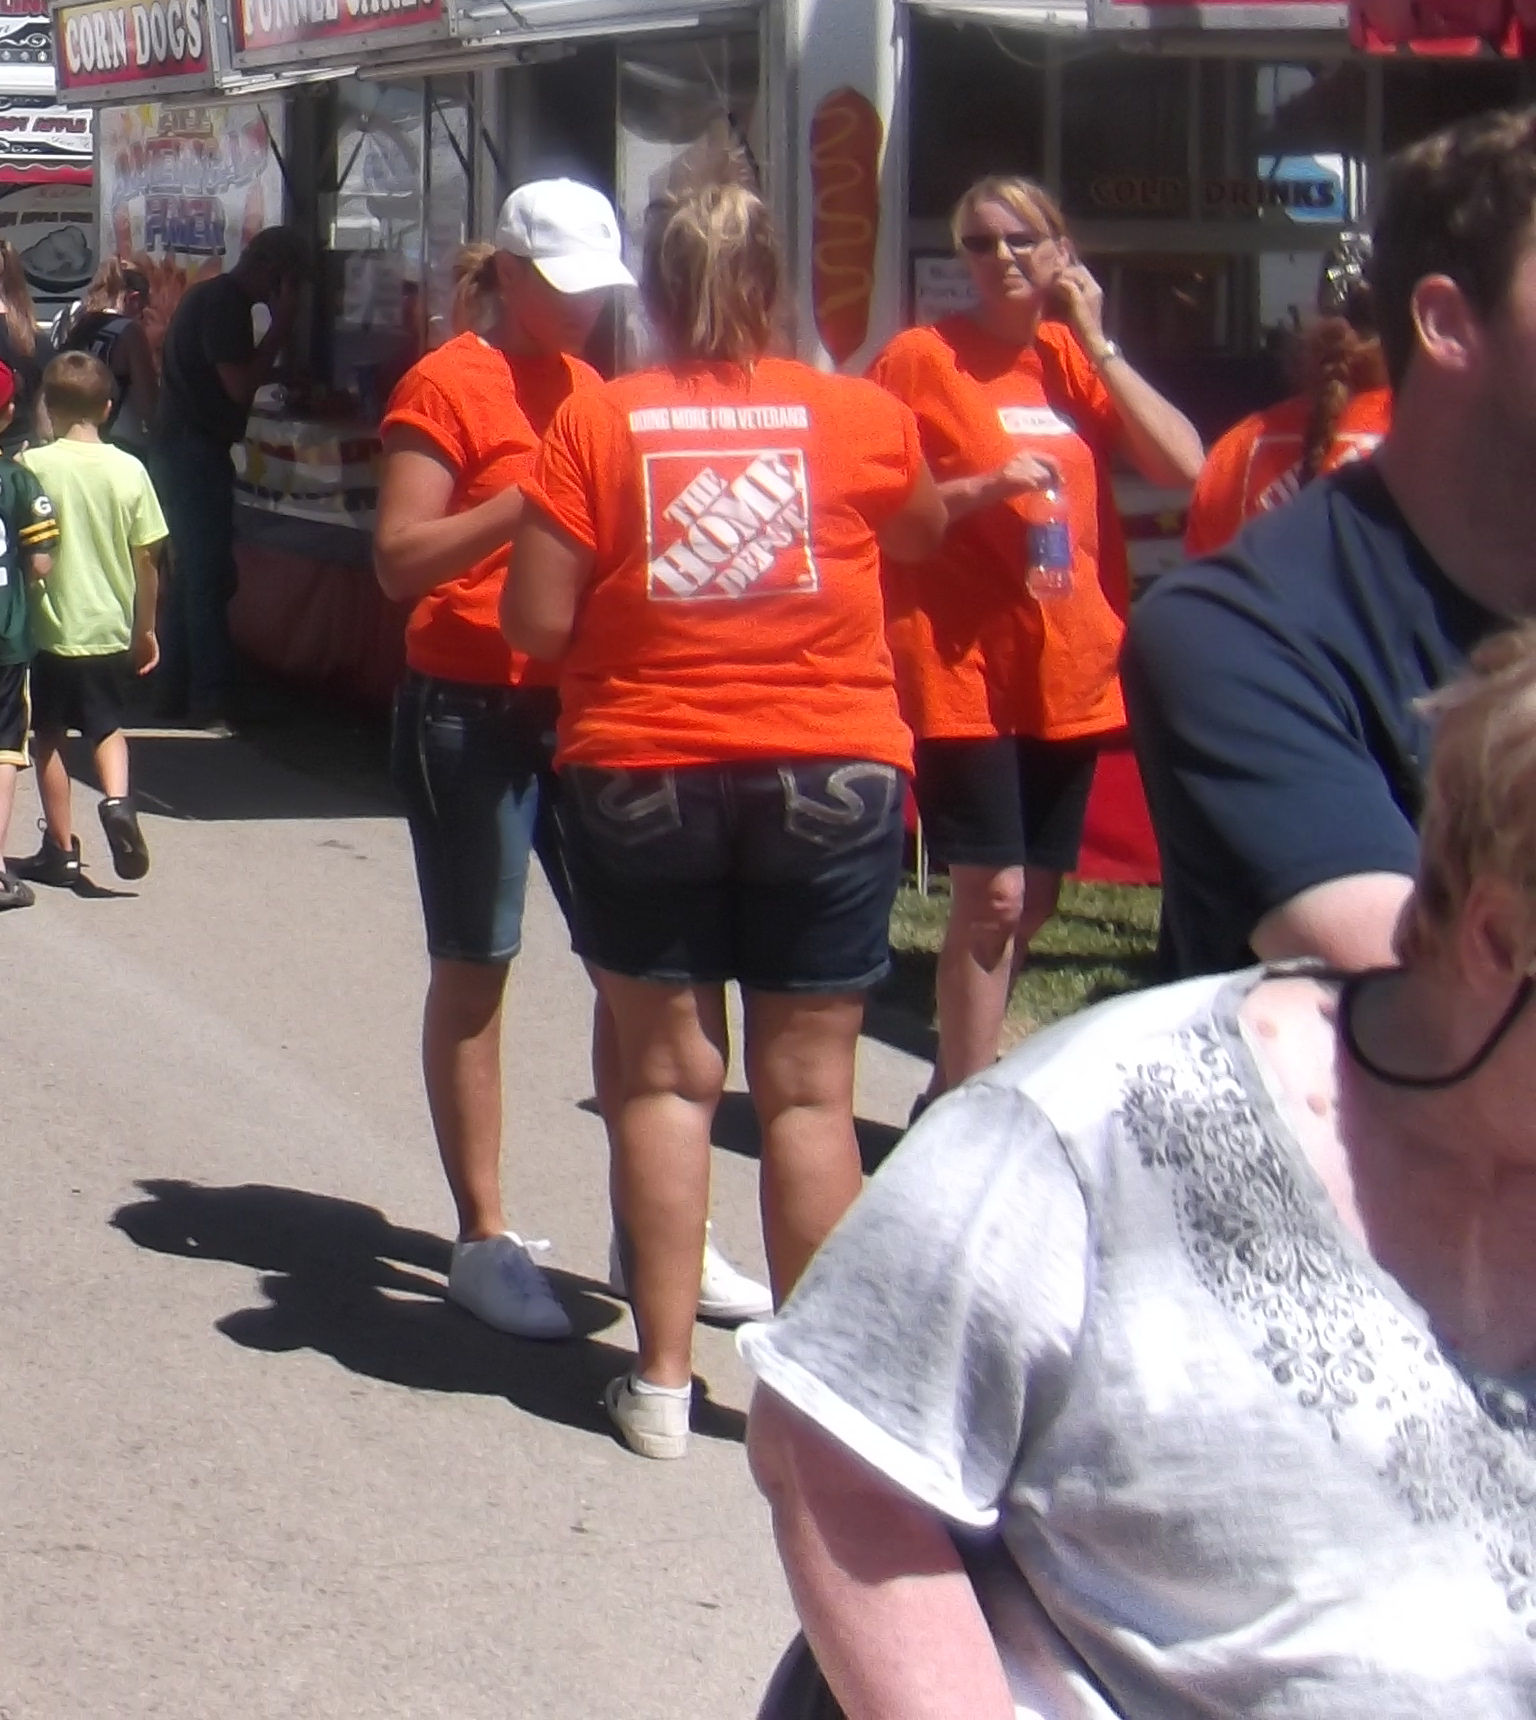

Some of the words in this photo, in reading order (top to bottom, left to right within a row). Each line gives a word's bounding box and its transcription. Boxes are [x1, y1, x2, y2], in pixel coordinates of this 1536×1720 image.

[64, 4, 129, 75] CORN
[711, 406, 737, 430] FOR
[33, 496, 52, 515] G
[650, 452, 805, 598] HOME
[662, 466, 729, 529] THE
[715, 502, 808, 599] DEPOT
